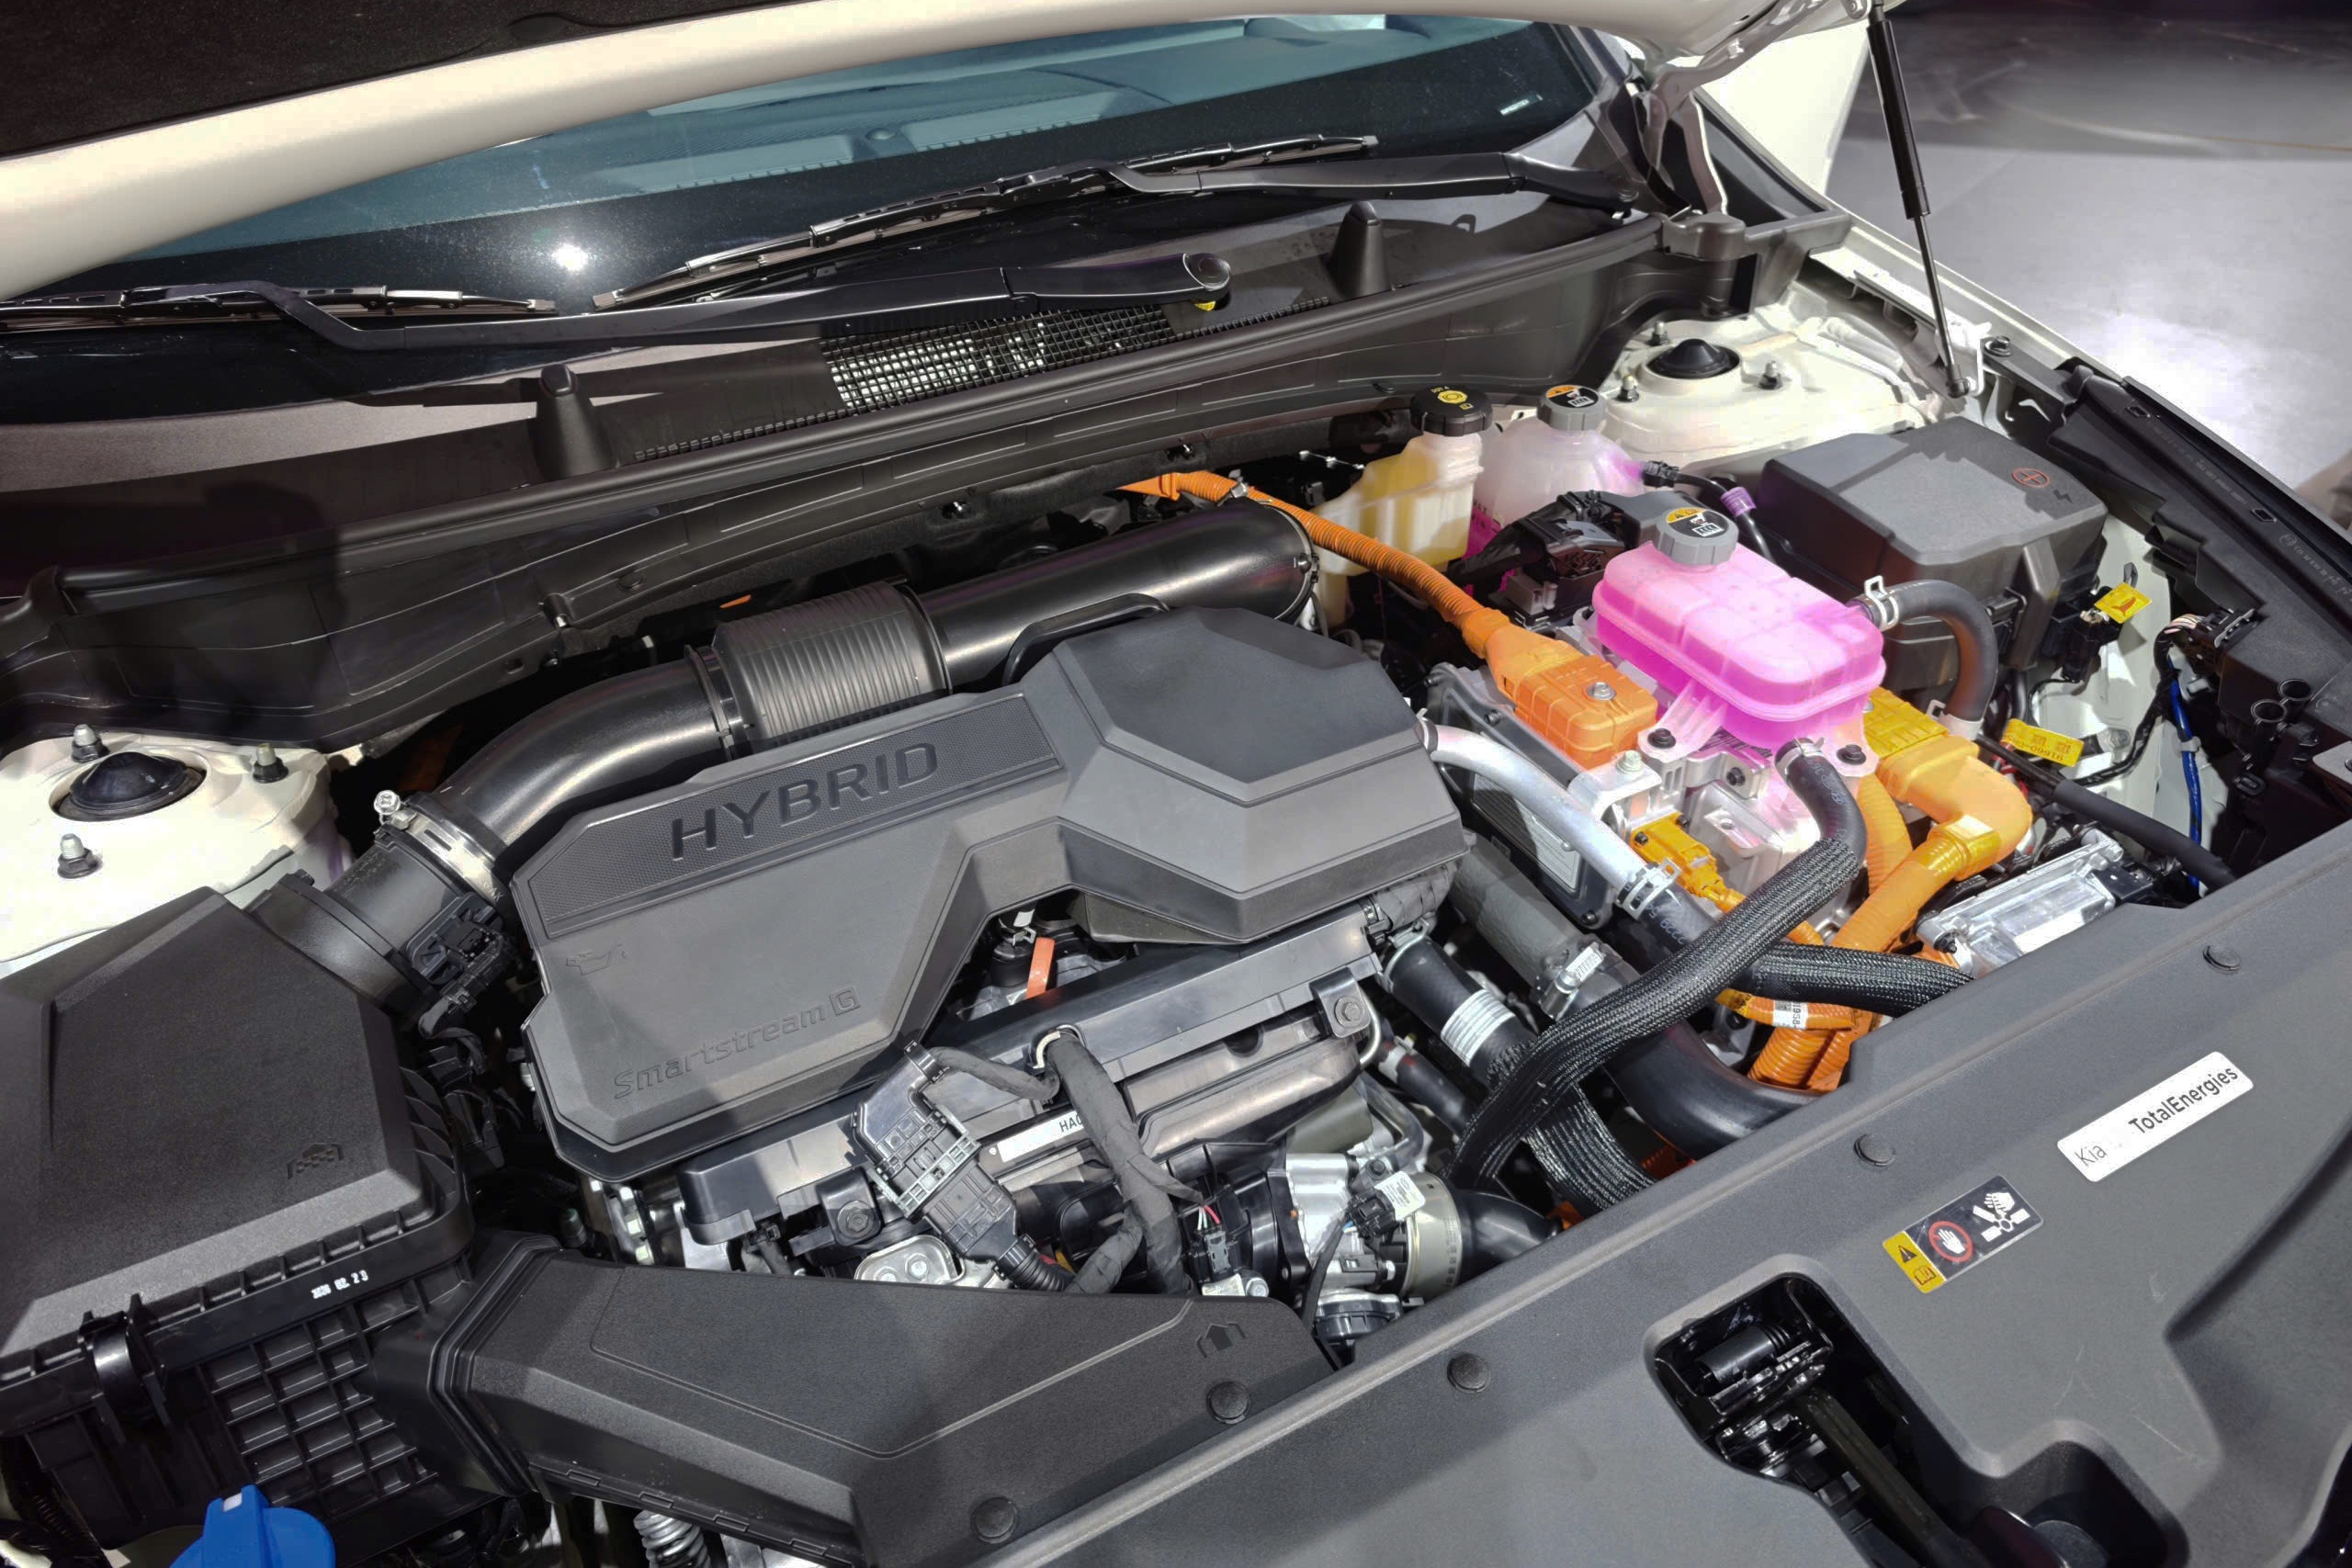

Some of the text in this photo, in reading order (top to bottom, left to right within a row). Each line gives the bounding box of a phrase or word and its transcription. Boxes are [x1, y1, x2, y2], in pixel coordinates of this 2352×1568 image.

[672, 743, 938, 861] HYBRID
[614, 987, 861, 1099] Smartstream G
[2128, 1066, 2238, 1134] TotalEnergies
[2075, 1143, 2107, 1168] Kia
